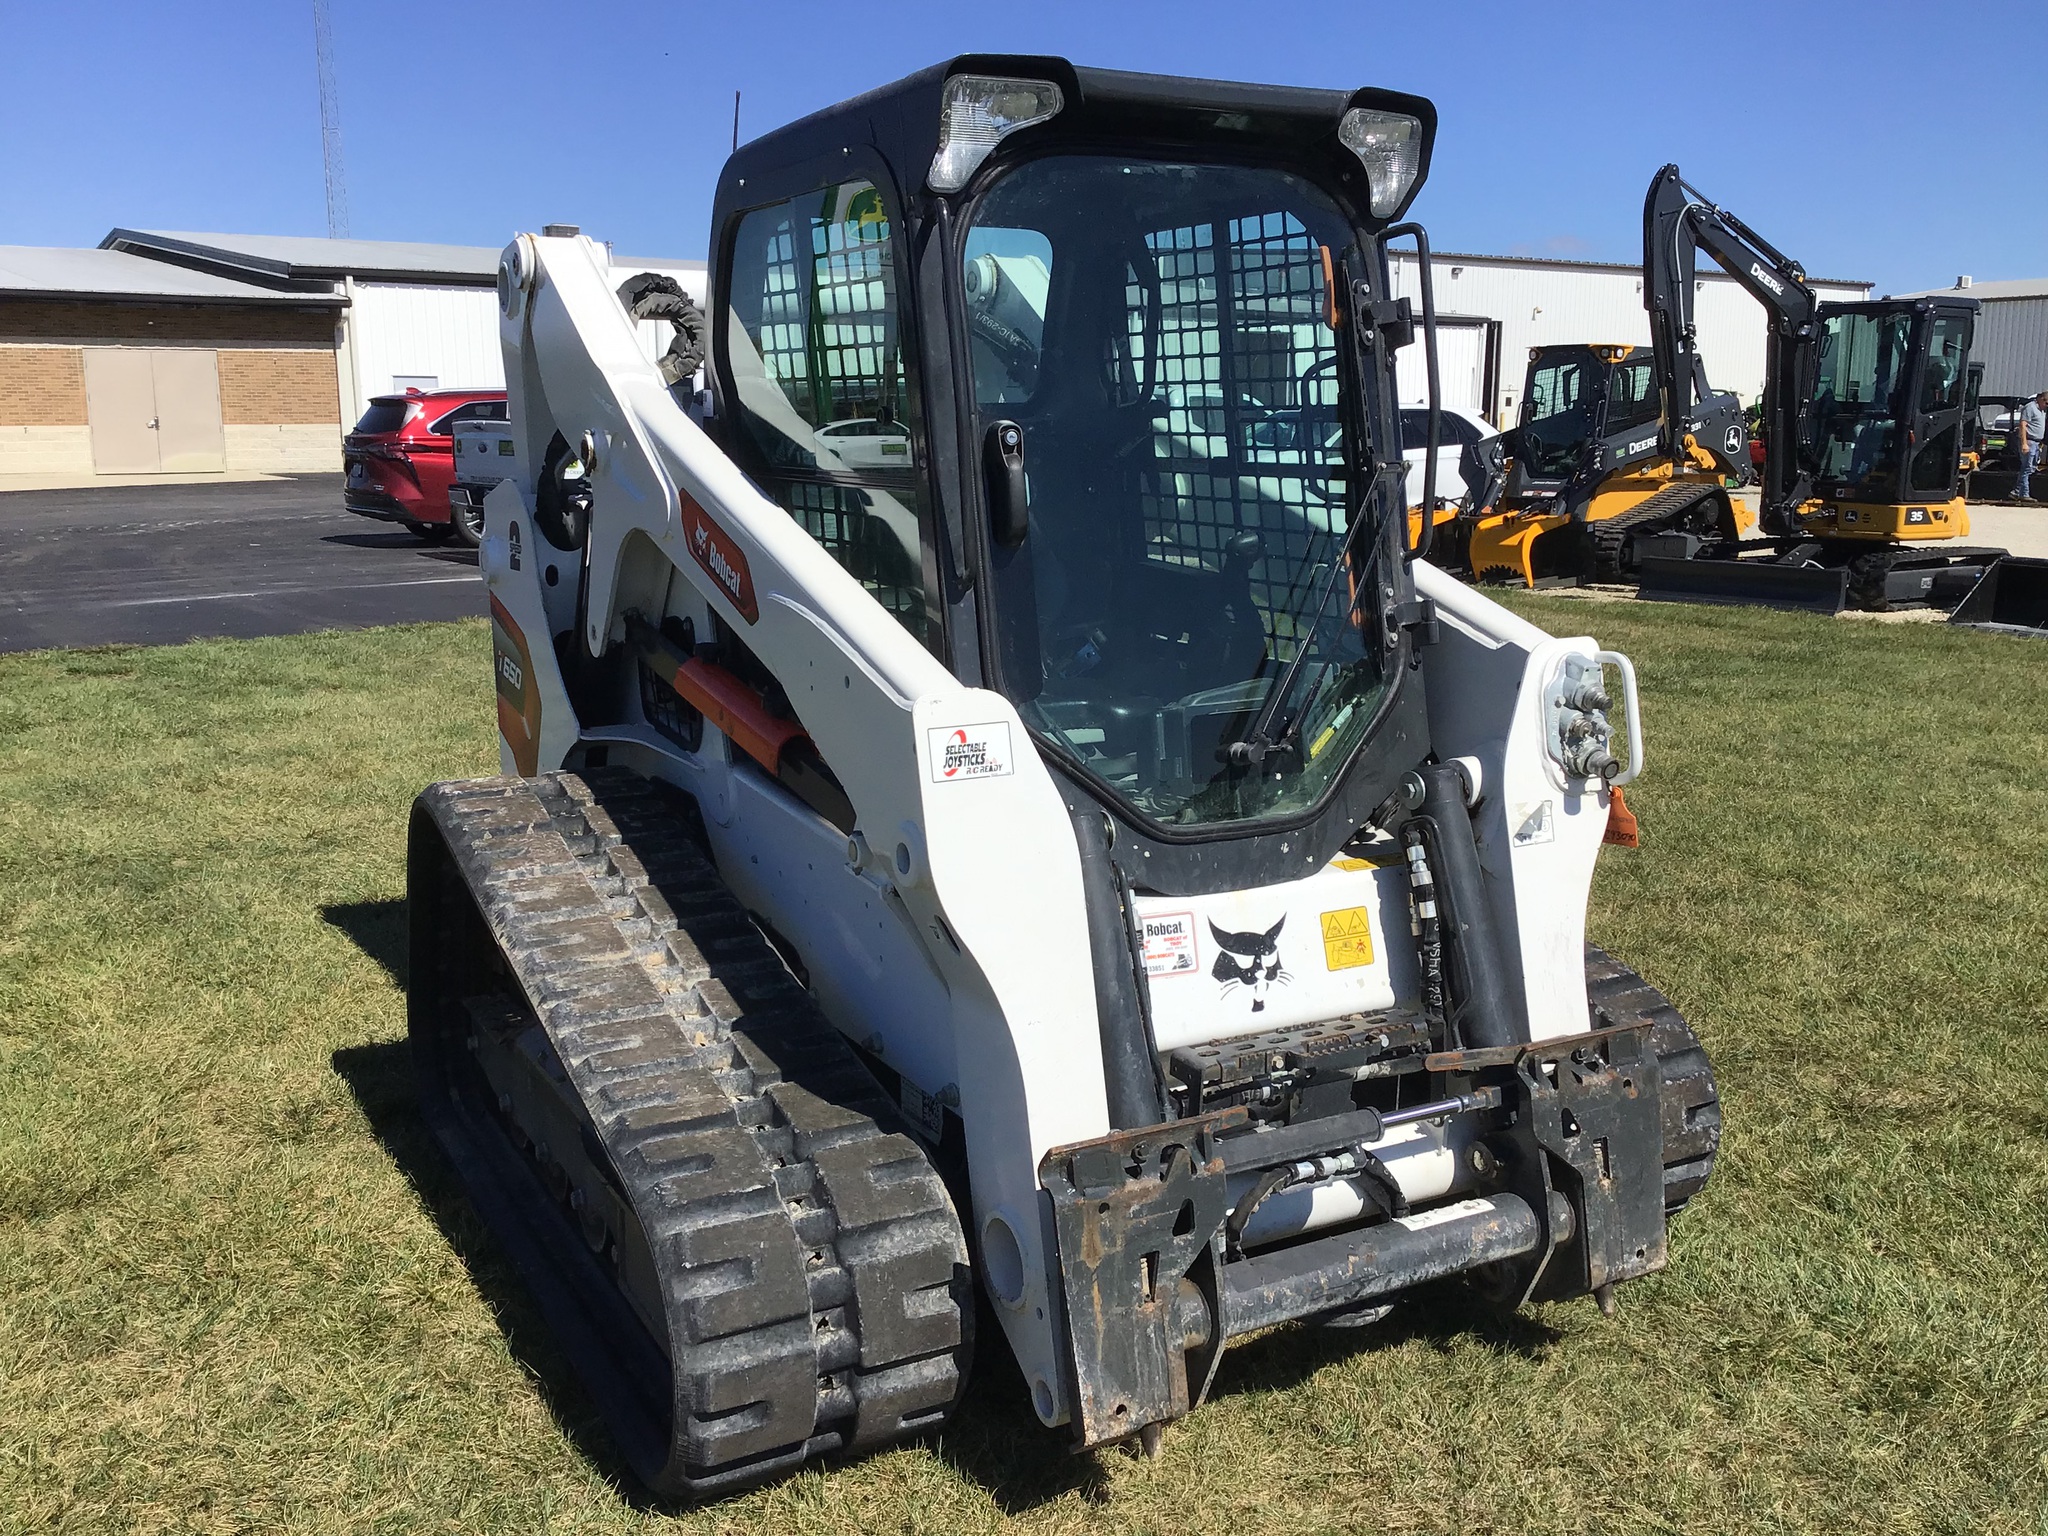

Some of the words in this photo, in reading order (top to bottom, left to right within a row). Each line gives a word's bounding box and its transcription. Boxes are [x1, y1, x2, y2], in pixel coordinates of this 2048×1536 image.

[1751, 262, 1784, 296] DEERE
[1629, 435, 1658, 455] DEERE
[1910, 511, 1924, 522] 35
[709, 541, 741, 598] Bobcat
[945, 742, 987, 755] SELECTABLE
[943, 753, 986, 769] JOYSTICKS
[980, 763, 1003, 774] READY
[1146, 921, 1183, 937] Bobcat
